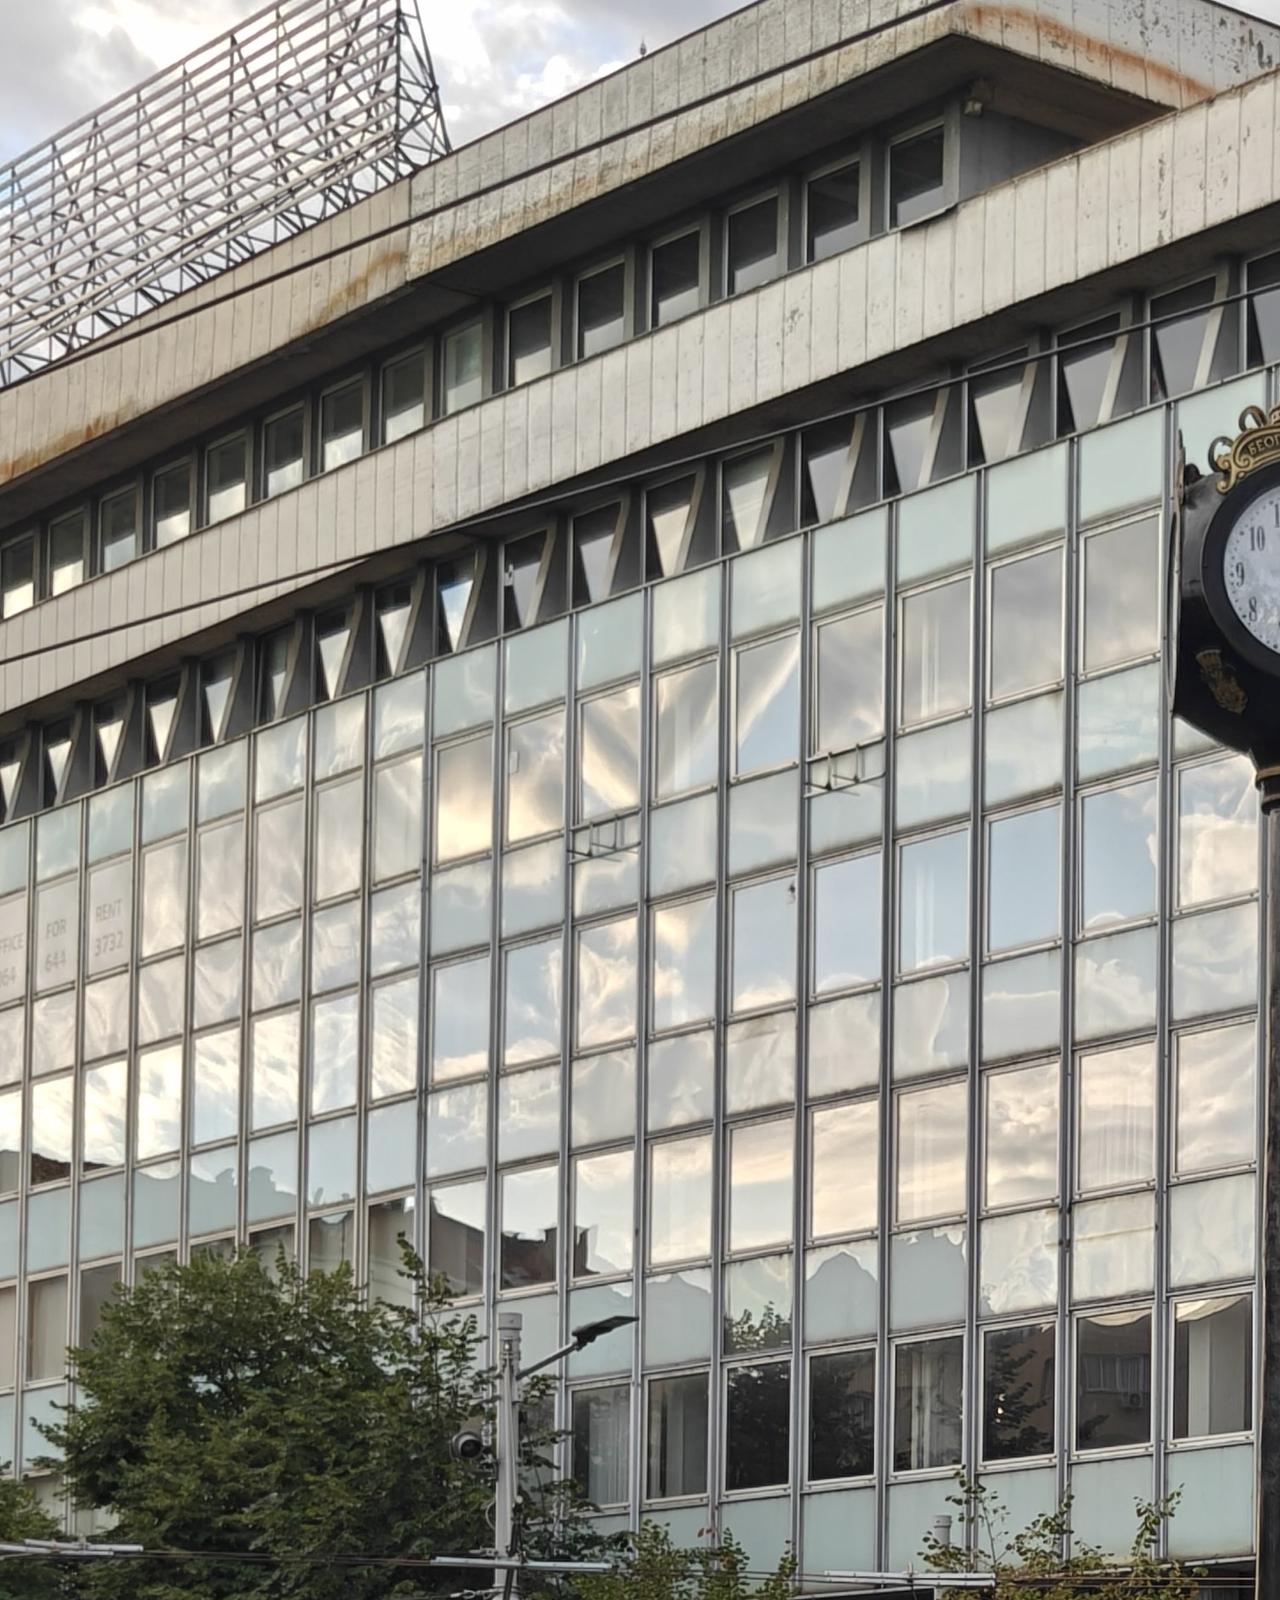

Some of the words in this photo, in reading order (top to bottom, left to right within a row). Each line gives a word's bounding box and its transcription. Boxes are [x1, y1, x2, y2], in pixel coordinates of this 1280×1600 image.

[1250, 526, 1266, 552] 10
[1236, 563, 1245, 587] 9
[1249, 597, 1258, 622] 8
